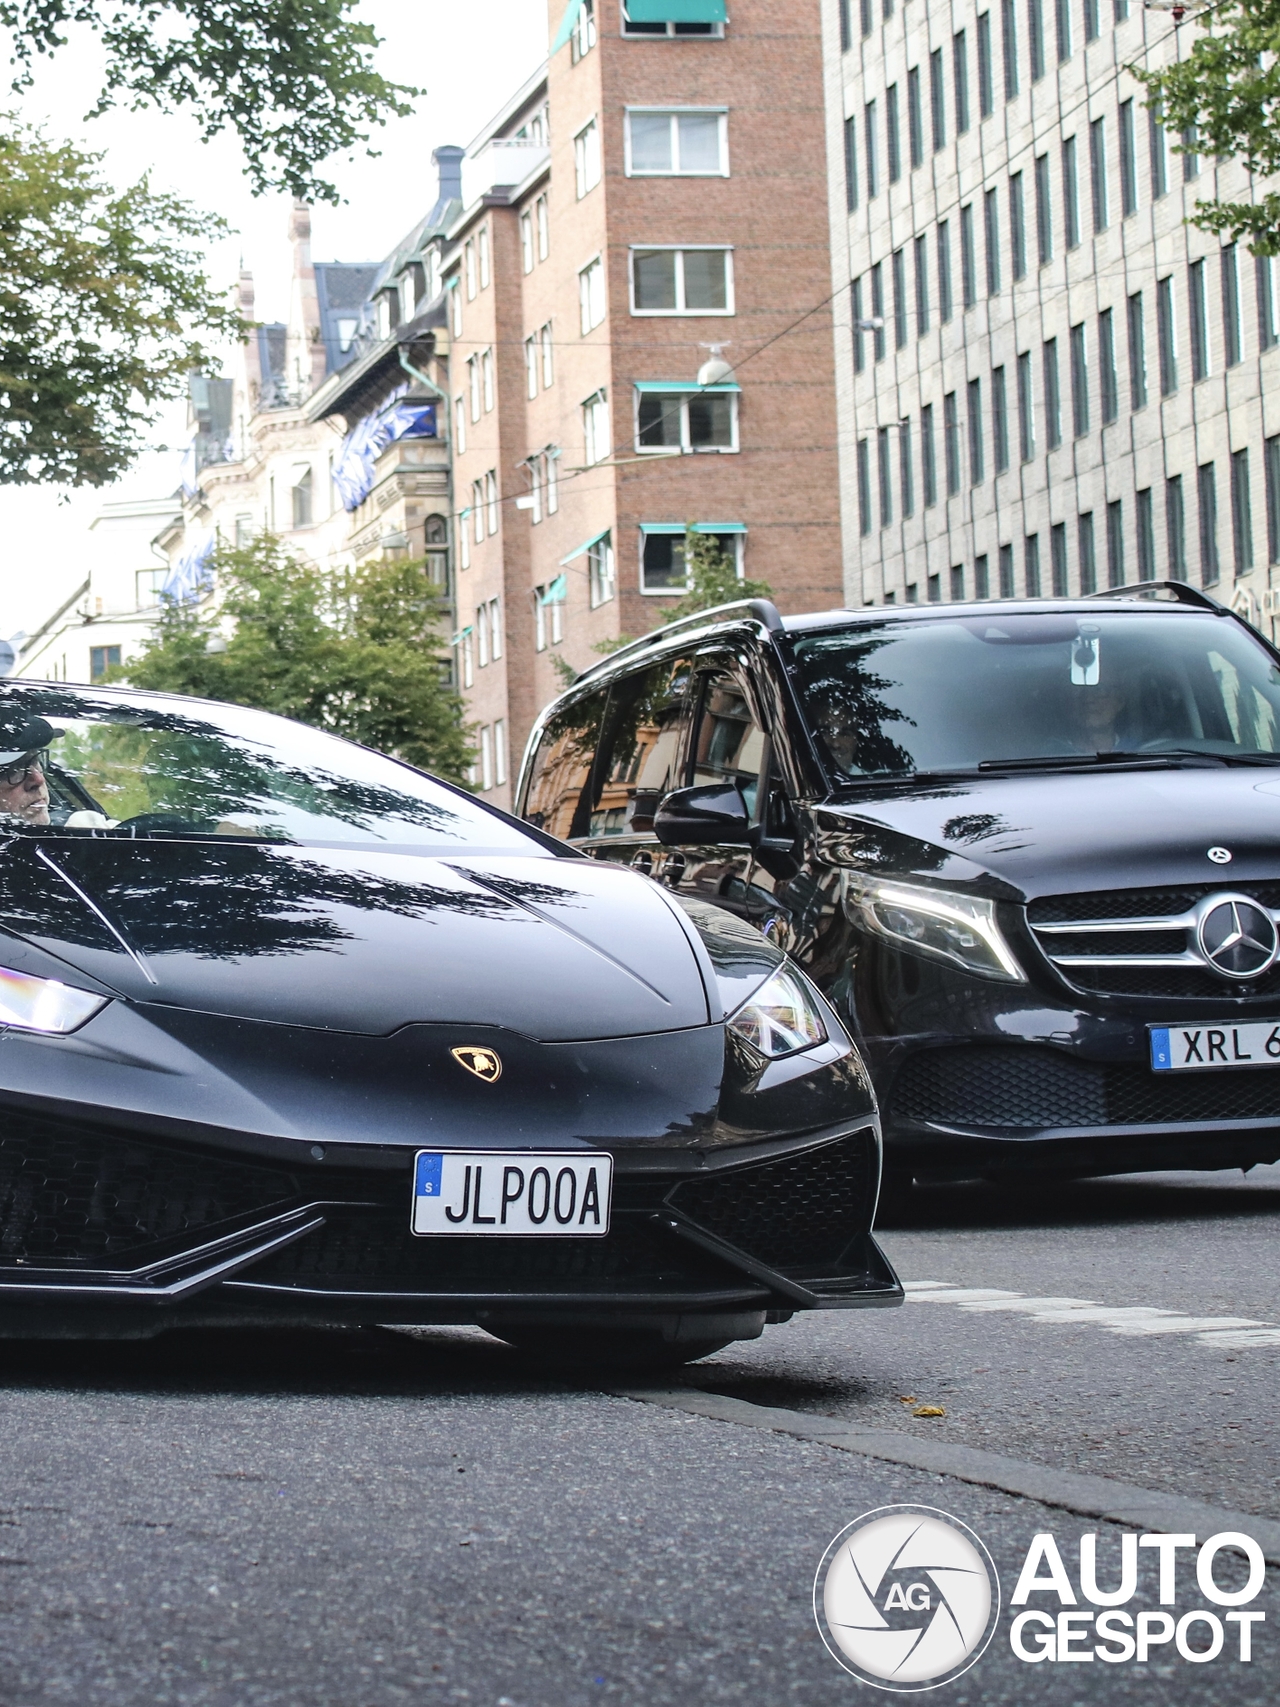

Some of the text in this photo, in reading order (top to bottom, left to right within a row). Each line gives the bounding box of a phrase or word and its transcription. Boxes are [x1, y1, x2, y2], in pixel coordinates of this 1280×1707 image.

[1159, 1053, 1165, 1062] S
[1183, 1029, 1252, 1062] XRL
[425, 1182, 432, 1193] S
